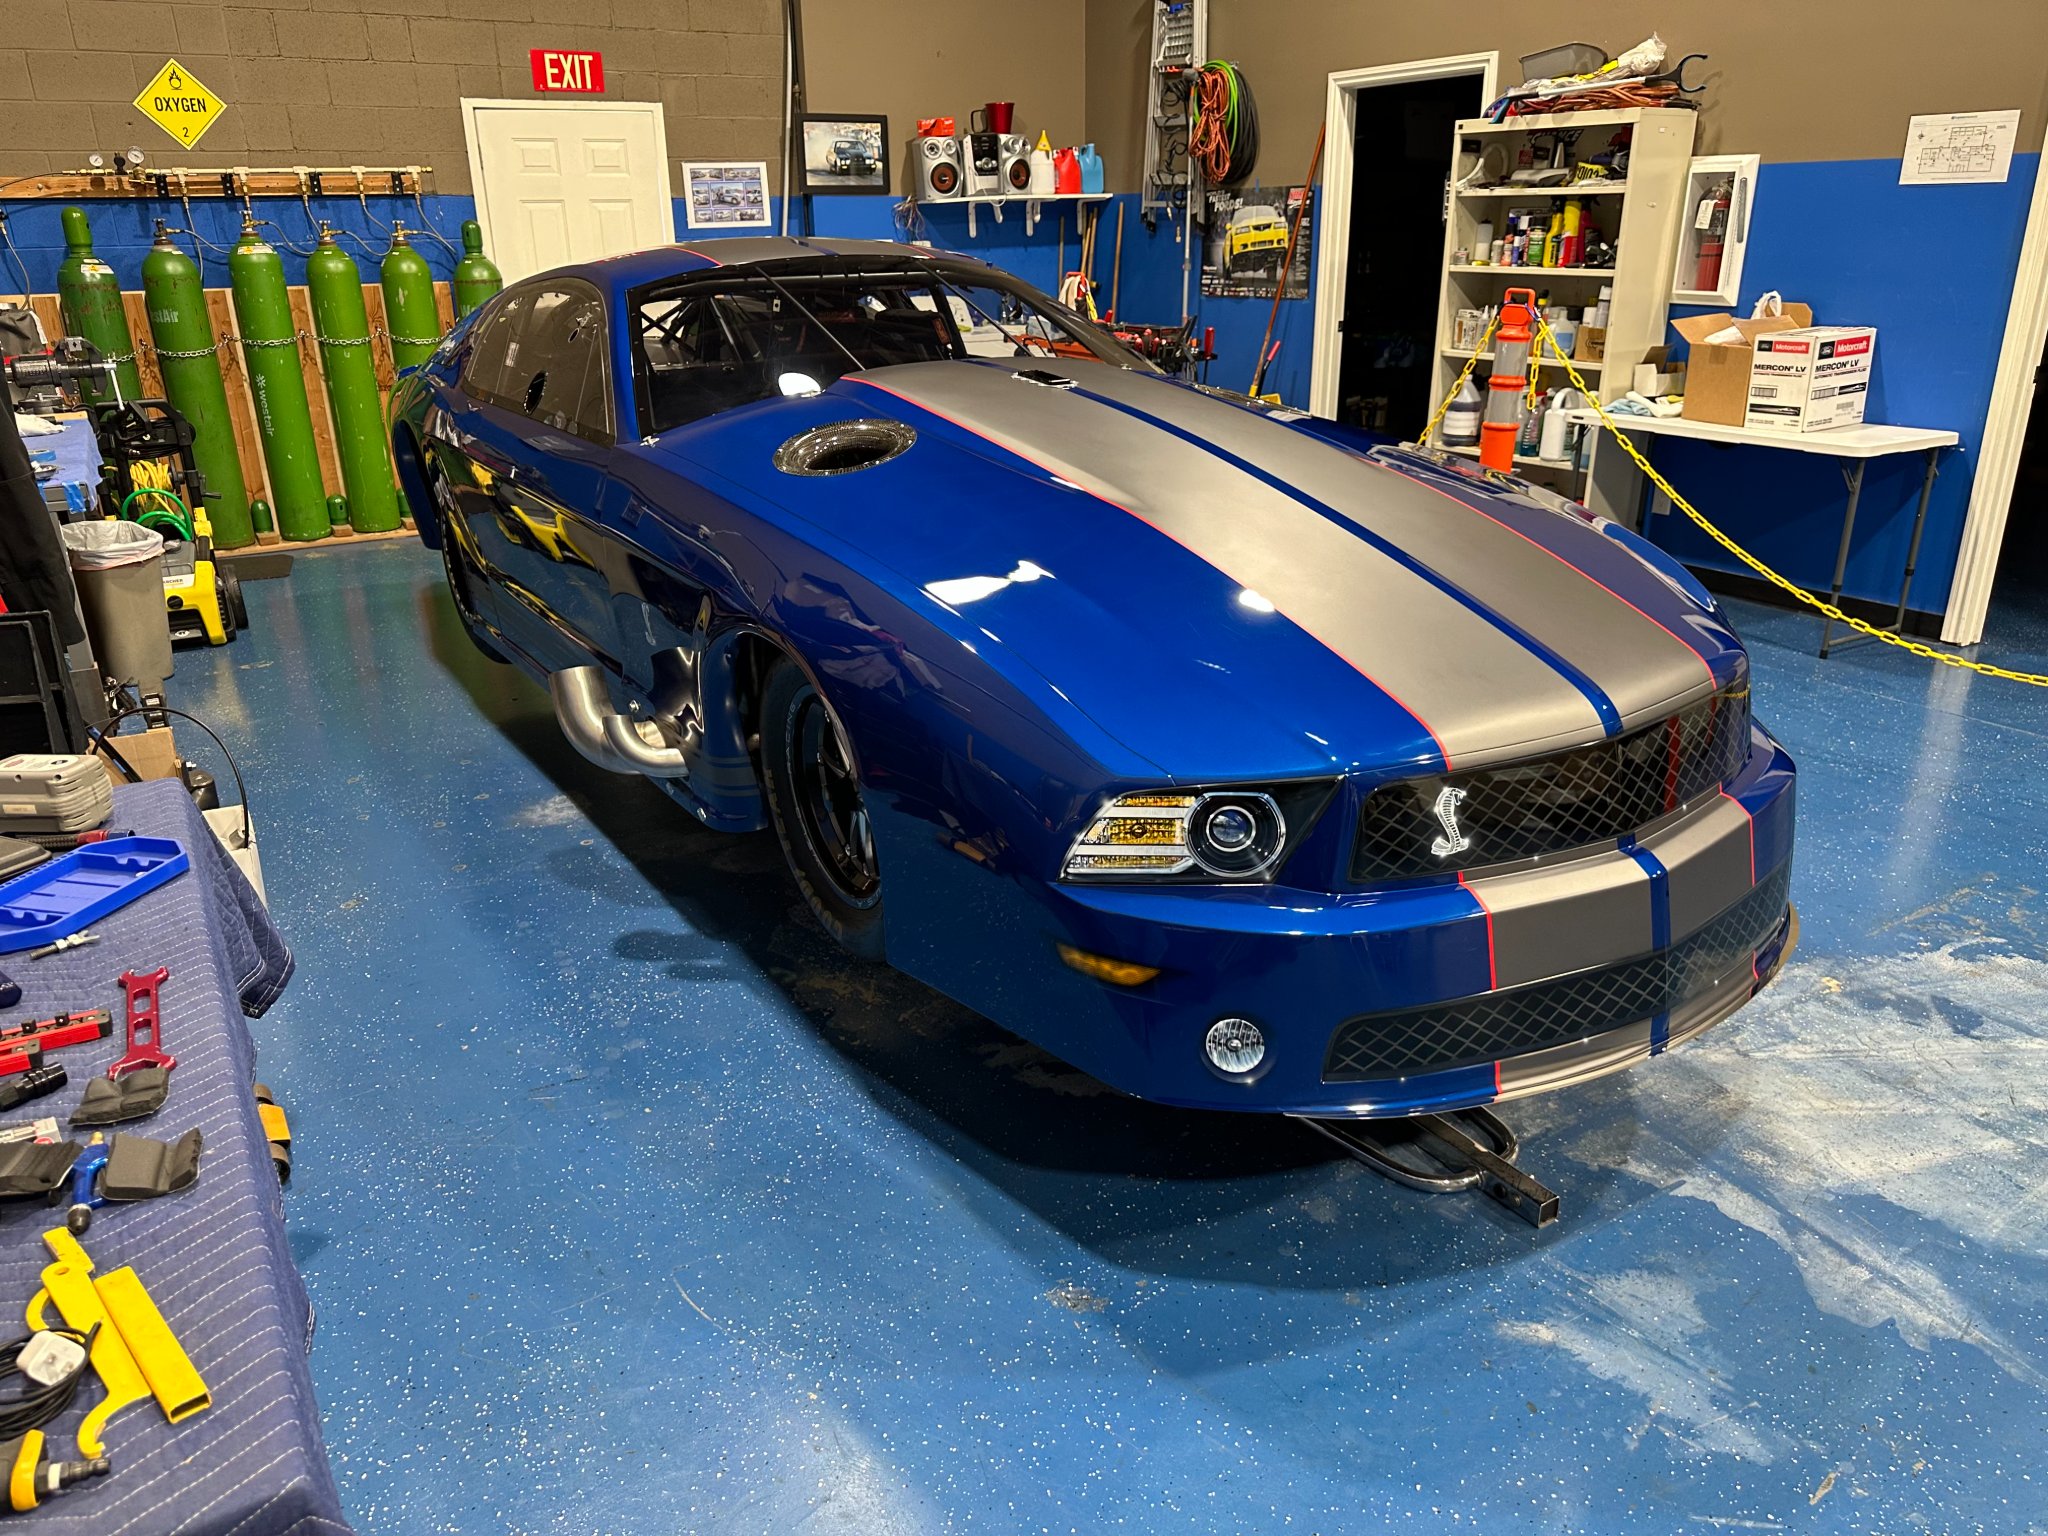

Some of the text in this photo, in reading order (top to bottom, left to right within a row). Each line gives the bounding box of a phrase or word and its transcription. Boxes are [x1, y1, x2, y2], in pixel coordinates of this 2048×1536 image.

[544, 53, 593, 89] EXIT
[154, 97, 207, 112] OXYGEN
[182, 126, 189, 137] 2
[1214, 198, 1243, 212] FORDS!
[1775, 342, 1807, 352] Motorcraft
[1837, 339, 1868, 353] Motorcraft
[1850, 359, 1860, 367] LV
[259, 389, 275, 437] westair
